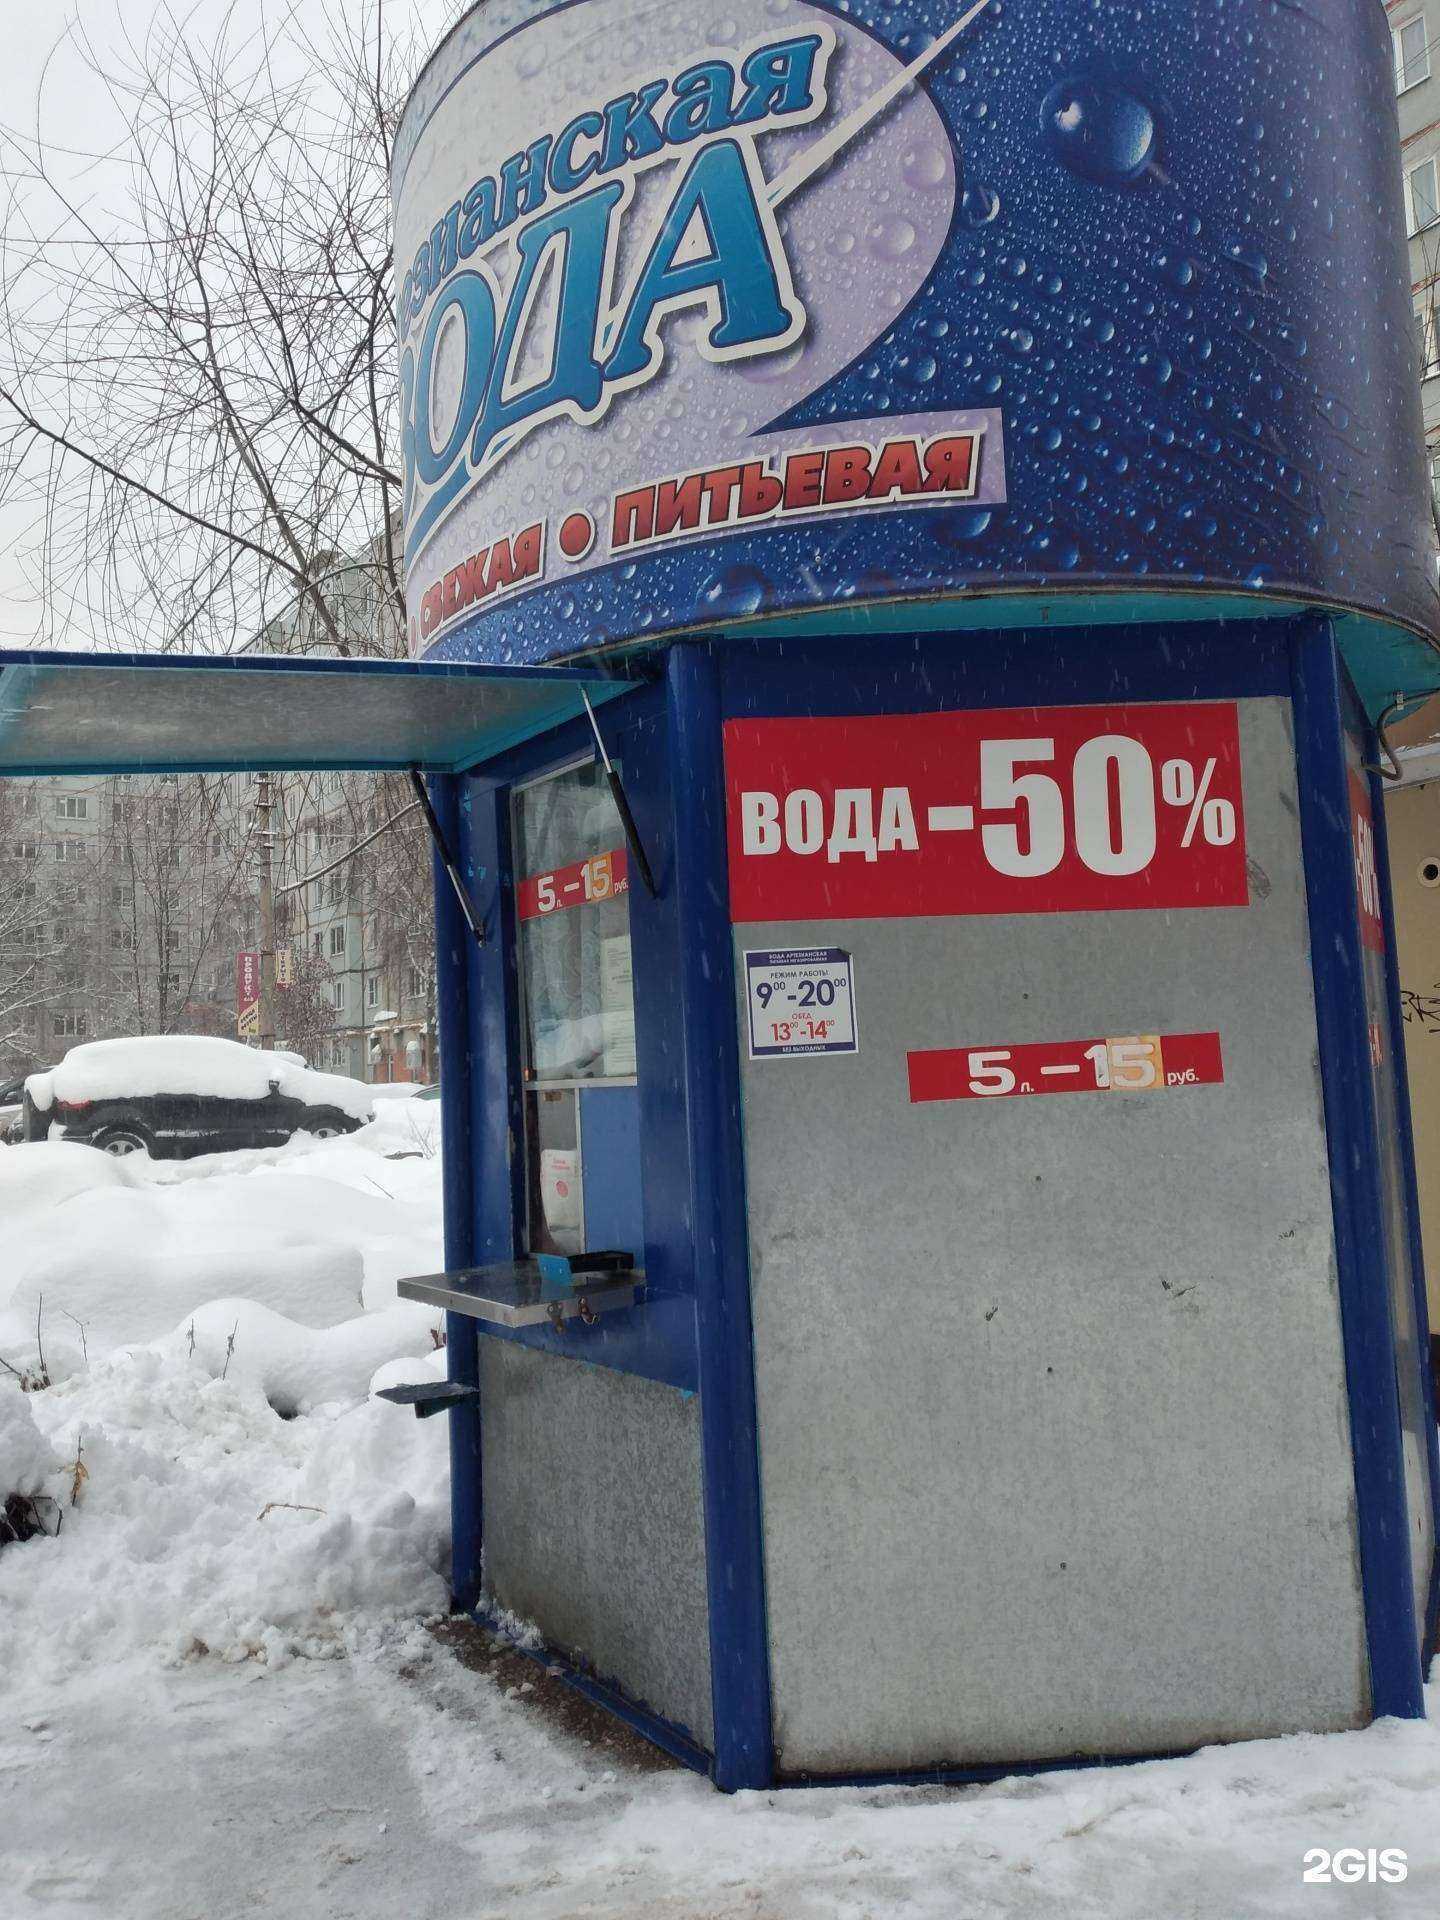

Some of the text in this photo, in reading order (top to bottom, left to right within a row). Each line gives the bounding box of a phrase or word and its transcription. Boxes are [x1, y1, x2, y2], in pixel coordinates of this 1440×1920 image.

[610, 436, 976, 548] ПИТЬЕВАЯ
[770, 969, 830, 979] РЕЖИМ РАБОТЫ
[791, 1012, 813, 1020] ОБЕД
[1167, 1069, 1200, 1086] руб.
